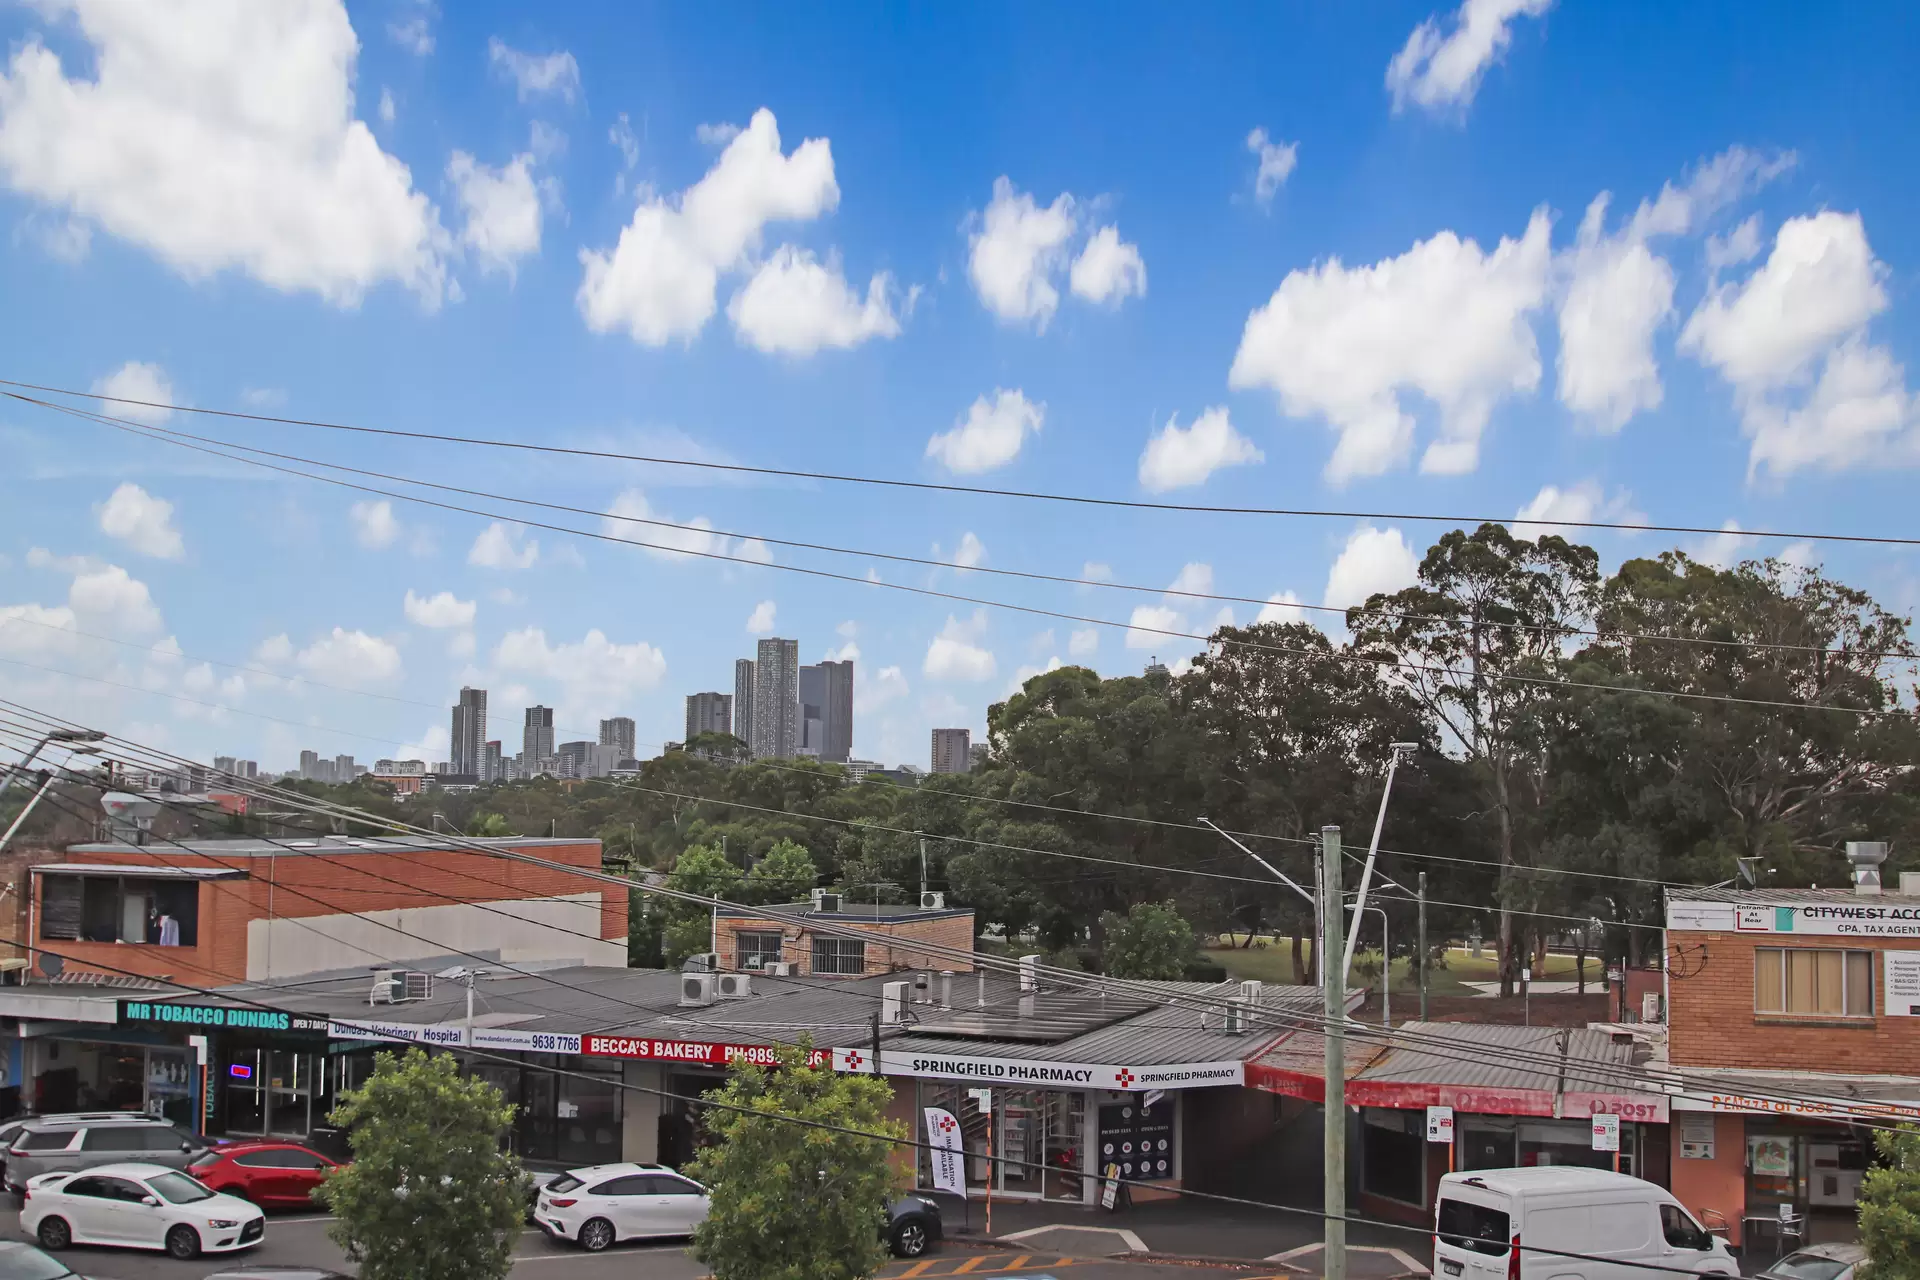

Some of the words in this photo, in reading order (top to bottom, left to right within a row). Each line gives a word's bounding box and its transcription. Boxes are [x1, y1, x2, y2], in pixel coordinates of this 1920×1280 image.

[1803, 906, 1886, 919] CITYWEST
[1837, 924, 1861, 933] CPA,
[1864, 925, 1884, 933] TAX
[127, 1003, 149, 1019] MR
[153, 1005, 224, 1025] TOBACCO
[227, 1010, 289, 1030] DUNDAS
[293, 1018, 307, 1028] OPEN
[312, 1020, 328, 1030] DAYS
[335, 1021, 367, 1035] Dundas
[371, 1025, 418, 1040] Veterinary
[424, 1028, 461, 1043] Hospital
[532, 1035, 555, 1049] 9638
[557, 1036, 579, 1051] 7766
[590, 1038, 649, 1056] BECCA'S
[653, 1041, 713, 1060] BAKERY
[913, 1059, 1004, 1077] SPRINGFIELD
[1008, 1066, 1092, 1082] PHARMACY
[1140, 1072, 1190, 1083] SPRINGFIELD
[1191, 1069, 1235, 1079] PHARMACY
[1612, 1103, 1657, 1119] POST
